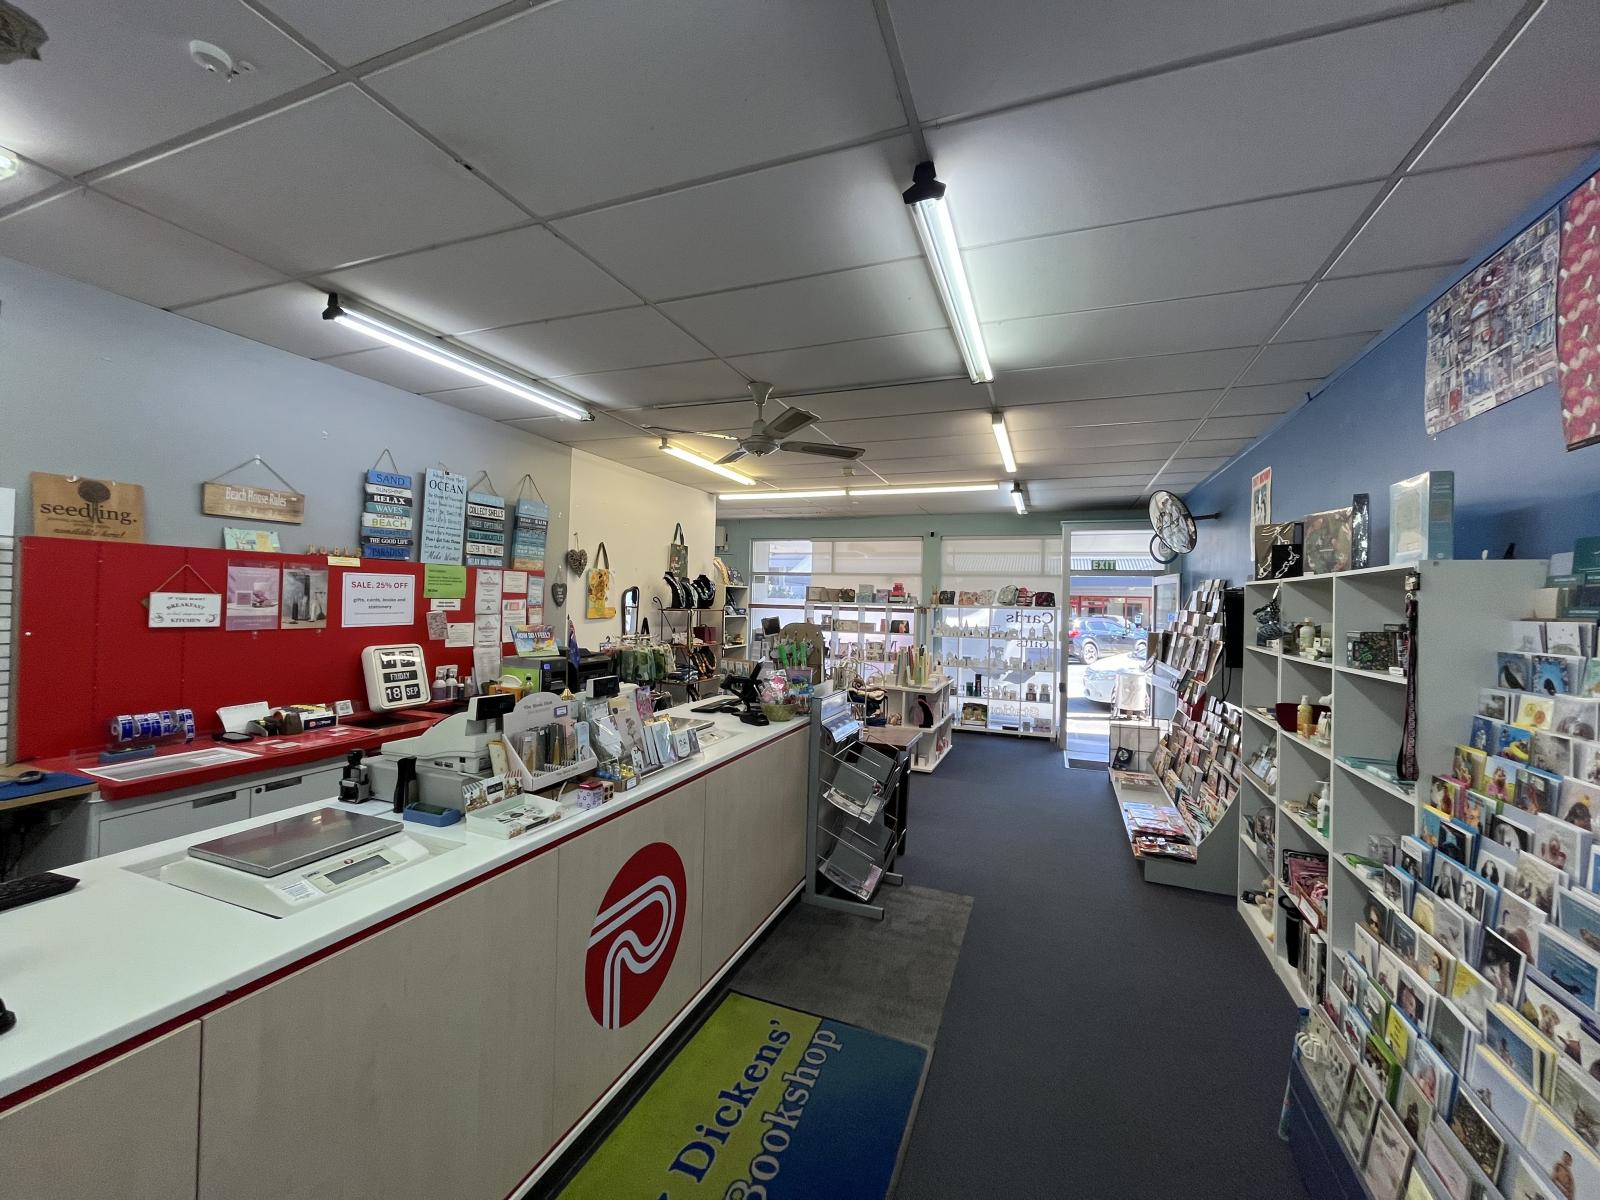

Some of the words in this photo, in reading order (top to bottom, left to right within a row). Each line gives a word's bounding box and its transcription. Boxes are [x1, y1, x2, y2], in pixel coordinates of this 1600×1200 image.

[376, 473, 405, 486] SAND
[429, 479, 464, 495] OCEAN
[225, 487, 247, 500] Beach
[247, 489, 269, 504] House
[269, 492, 287, 507] Rules
[373, 495, 406, 505] RELAX
[375, 505, 404, 514] WAVES
[468, 505, 488, 515] COLLECT
[488, 508, 504, 518] SHELLS
[371, 518, 408, 528] BEACH
[1092, 560, 1116, 570] EXIT
[375, 581, 392, 589] 25%
[166, 602, 206, 611] BREAKFAST
[516, 632, 528, 640] HOW
[528, 631, 535, 639] DO
[390, 671, 411, 681] FRIDAY
[386, 687, 401, 700] 18
[406, 686, 418, 696] SEP
[668, 1019, 791, 1183] Dickens'
